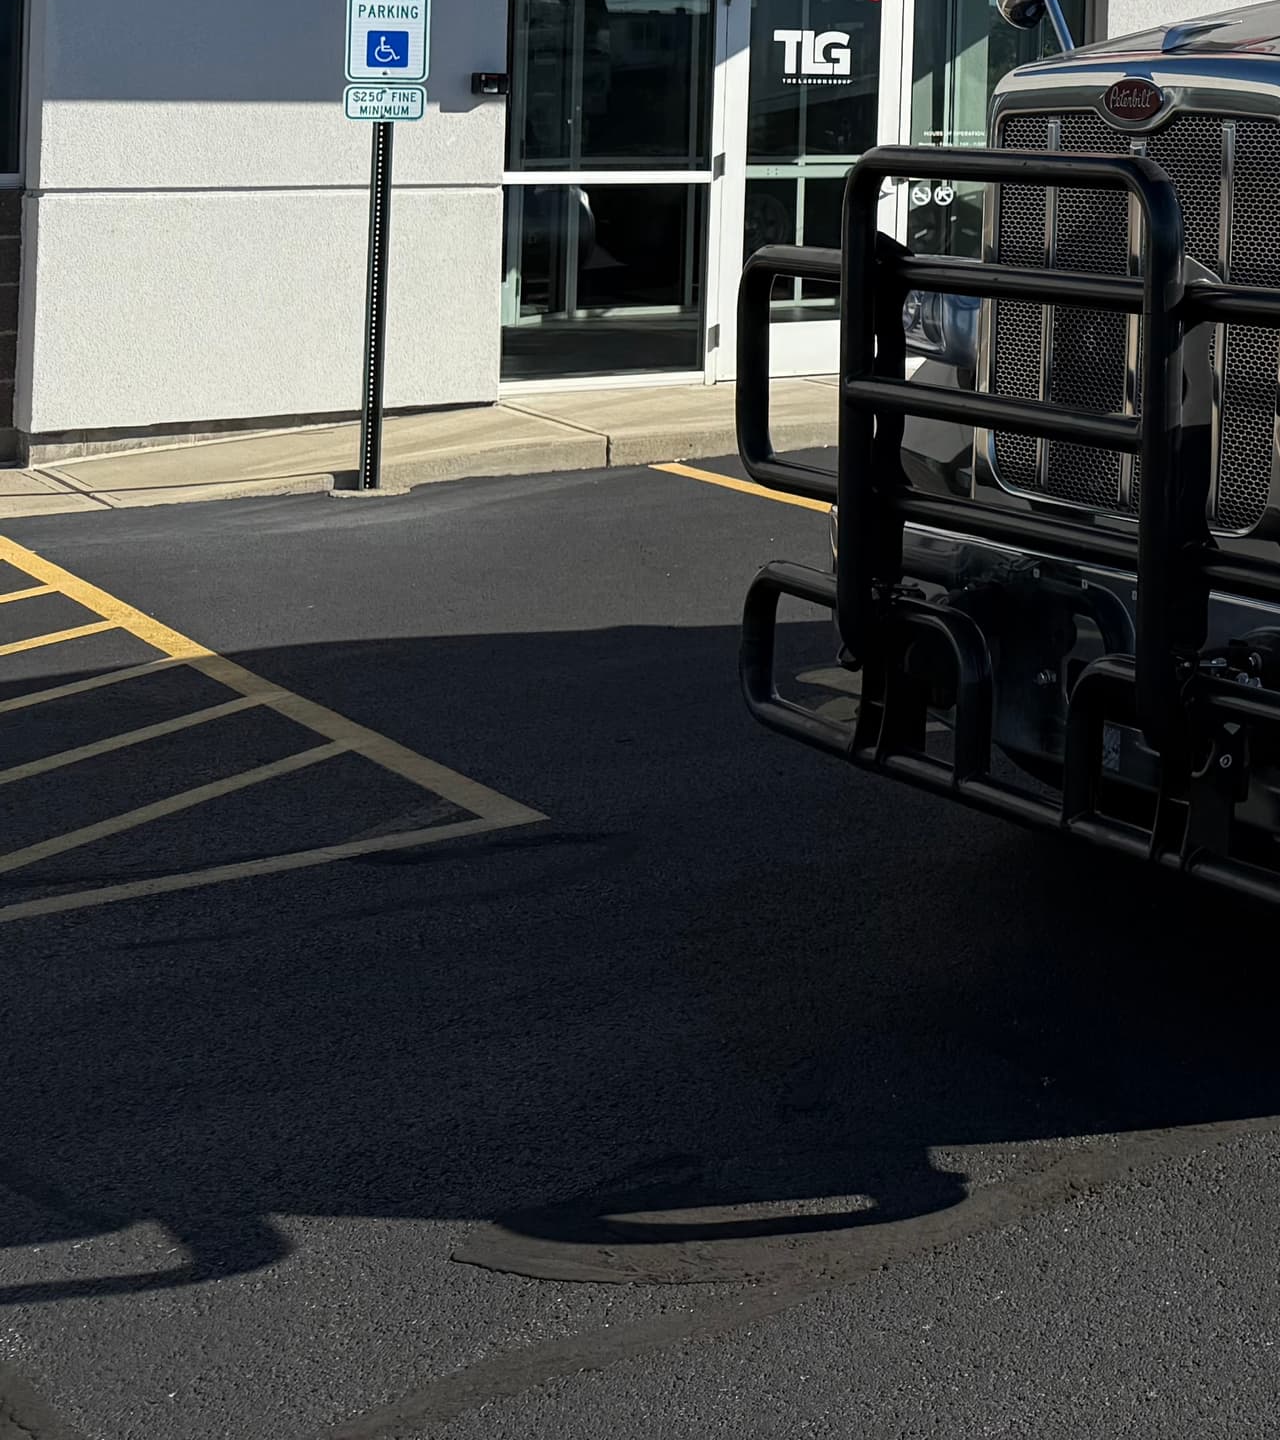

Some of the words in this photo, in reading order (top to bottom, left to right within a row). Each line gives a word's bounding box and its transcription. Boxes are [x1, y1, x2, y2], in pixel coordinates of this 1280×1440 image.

[358, 4, 419, 20] PARKING
[773, 30, 851, 75] TLG
[353, 91, 384, 103] $250
[391, 92, 417, 103] FINE
[1110, 86, 1155, 109] Peterbilt
[359, 105, 410, 117] MINIMUM
